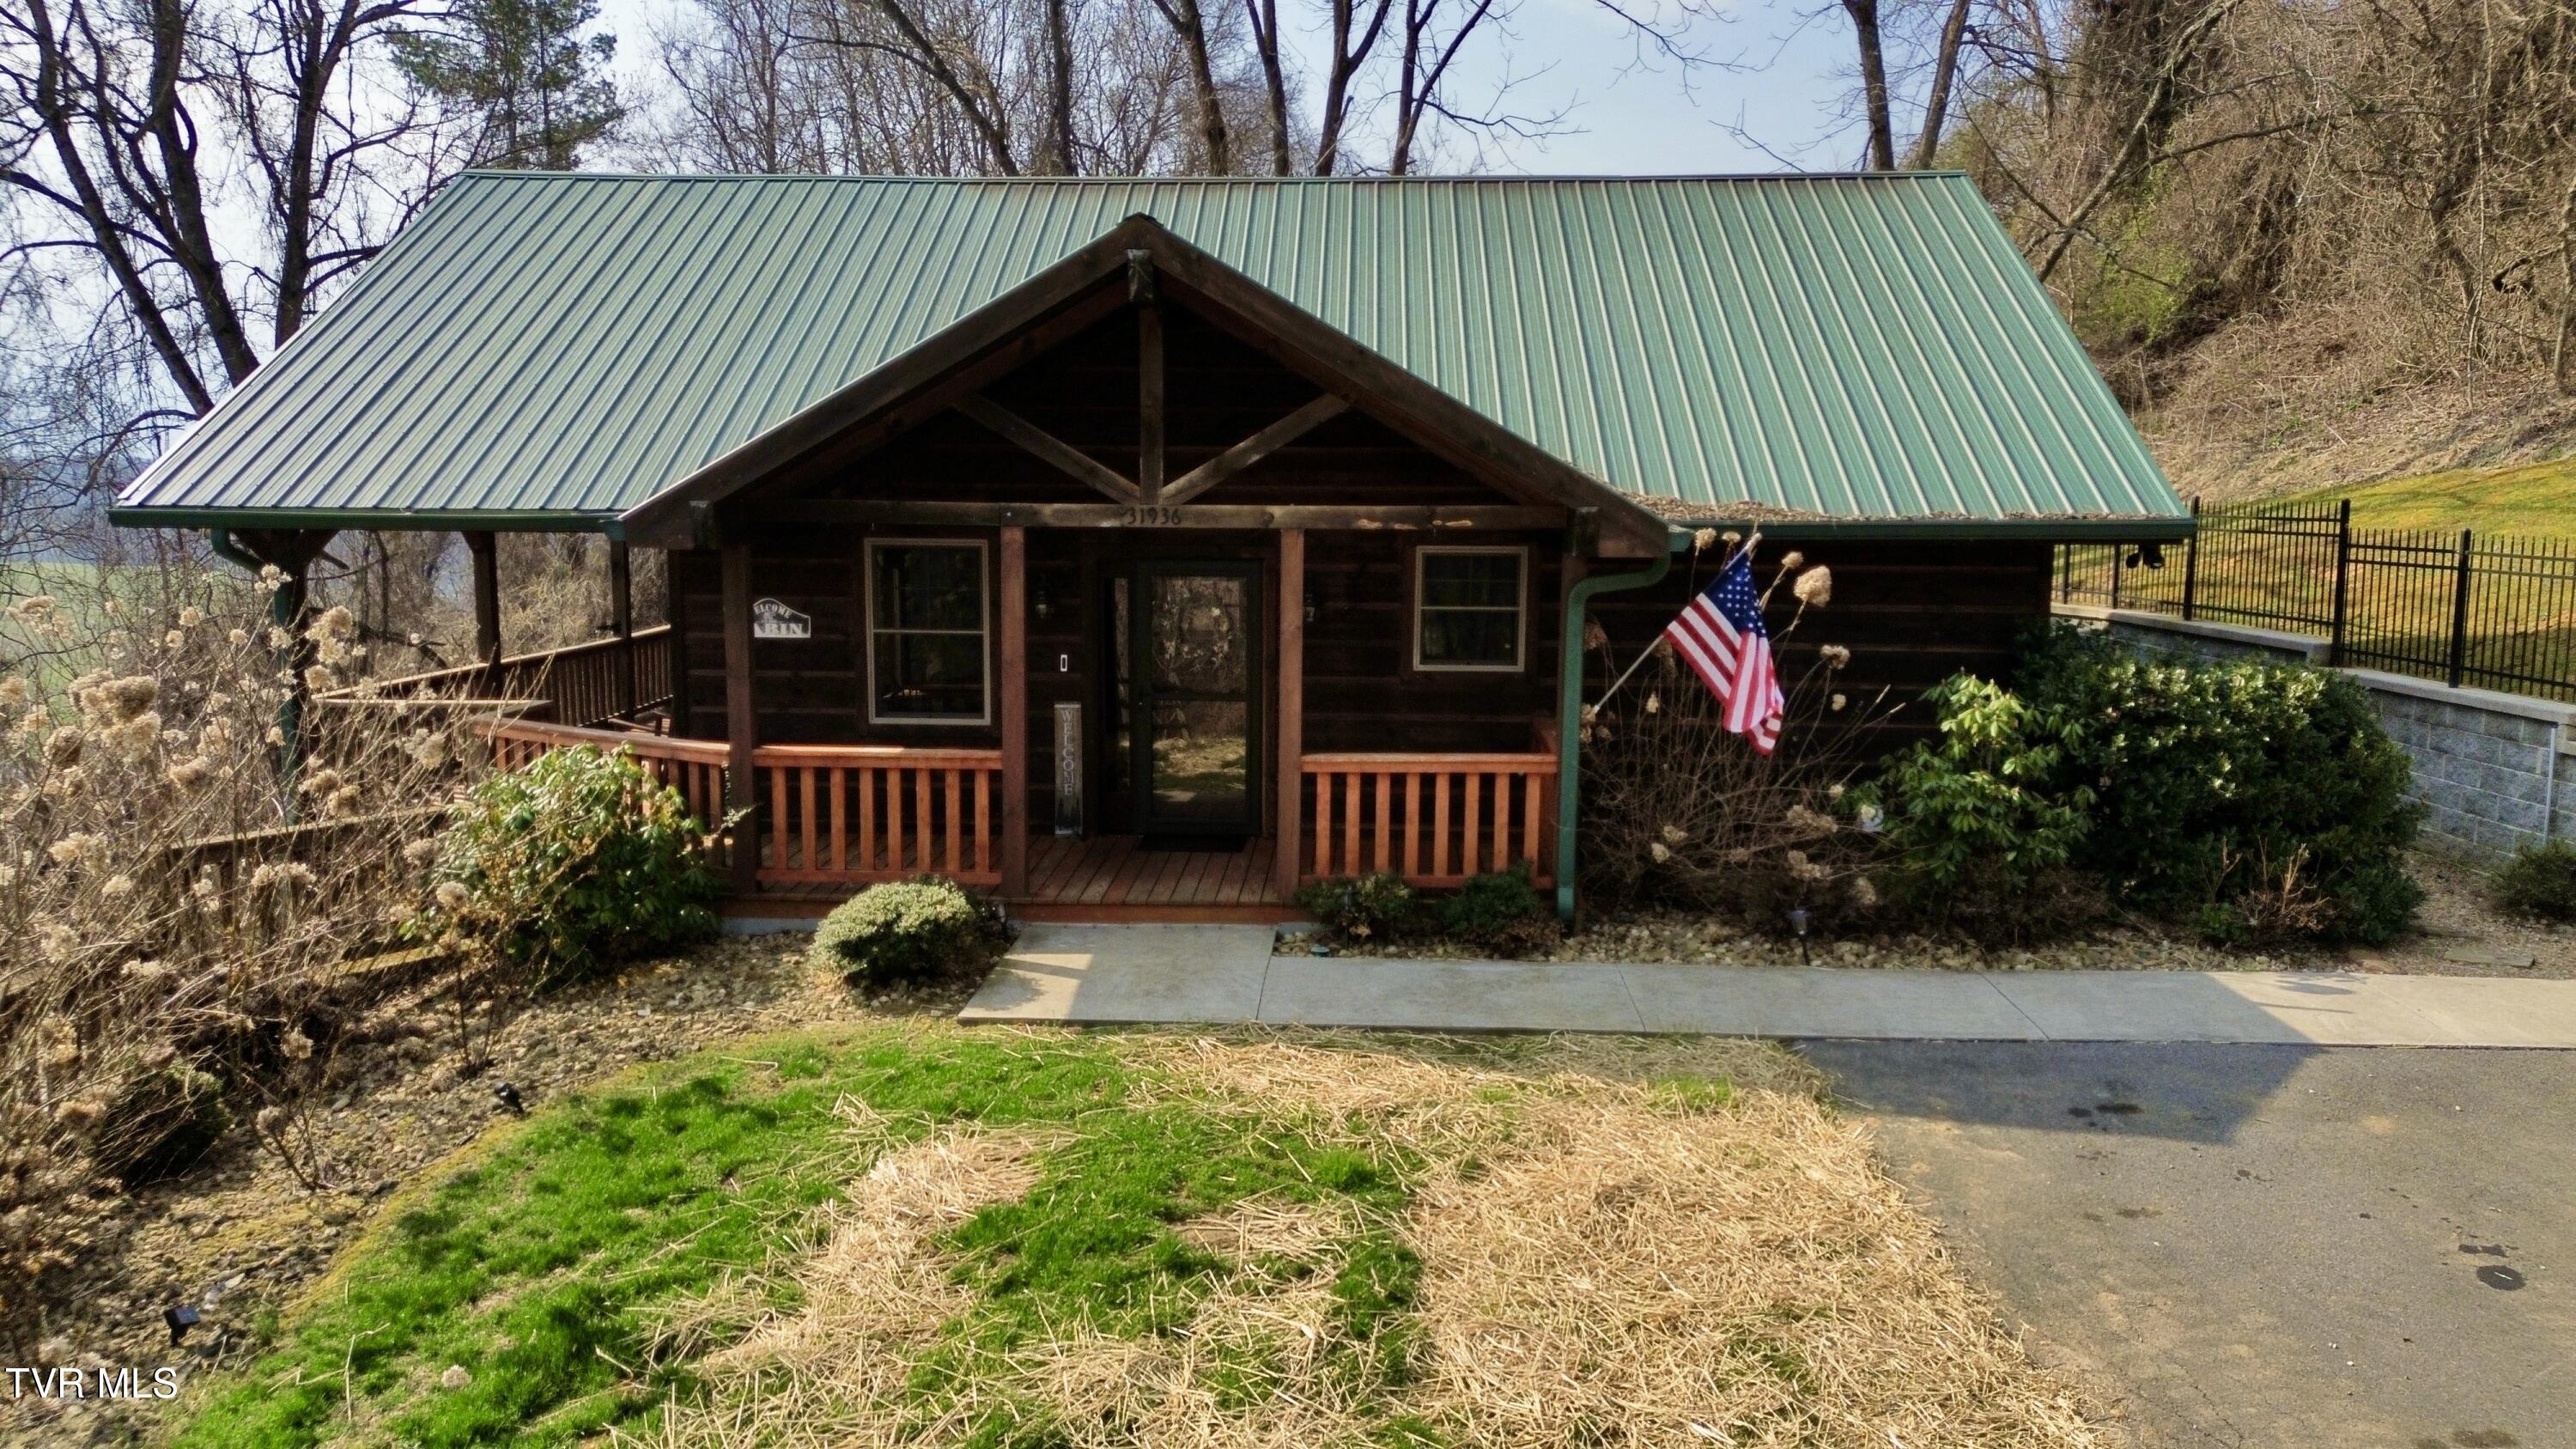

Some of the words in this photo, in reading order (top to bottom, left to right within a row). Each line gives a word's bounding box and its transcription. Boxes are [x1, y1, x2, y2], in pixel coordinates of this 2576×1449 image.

[1127, 507, 1182, 525] 31936
[755, 604, 791, 618] ELCOME
[1061, 709, 1074, 795] WELCOME
